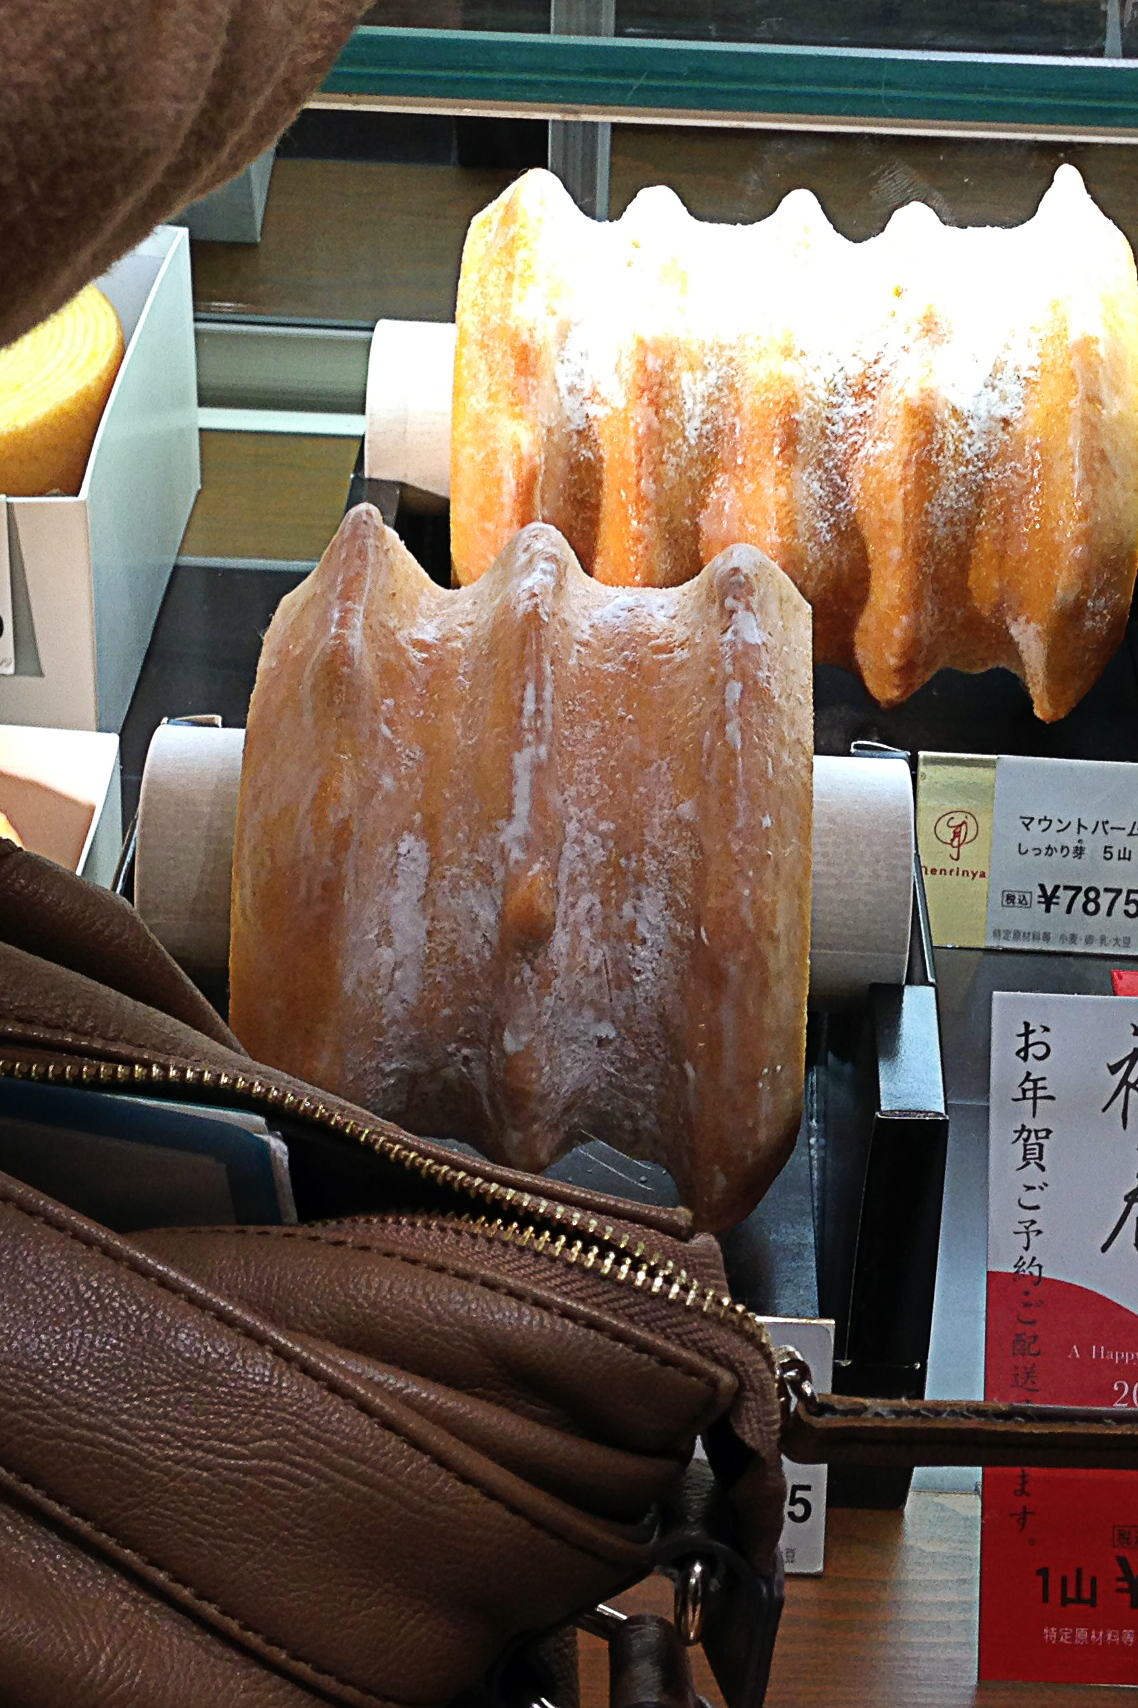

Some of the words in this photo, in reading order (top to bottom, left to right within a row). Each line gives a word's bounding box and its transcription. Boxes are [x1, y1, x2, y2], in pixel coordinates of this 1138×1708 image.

[1017, 841, 1087, 861] しっかり芽
[1102, 845, 1133, 862] 5山
[1004, 892, 1029, 908] 税込
[1009, 1020, 1057, 1547] お年賀ご予約・ご配送ます。
[1067, 1345, 1081, 1359] A
[1035, 1566, 1098, 1608] 1山
[1042, 1626, 1137, 1648] 特定原材料等
